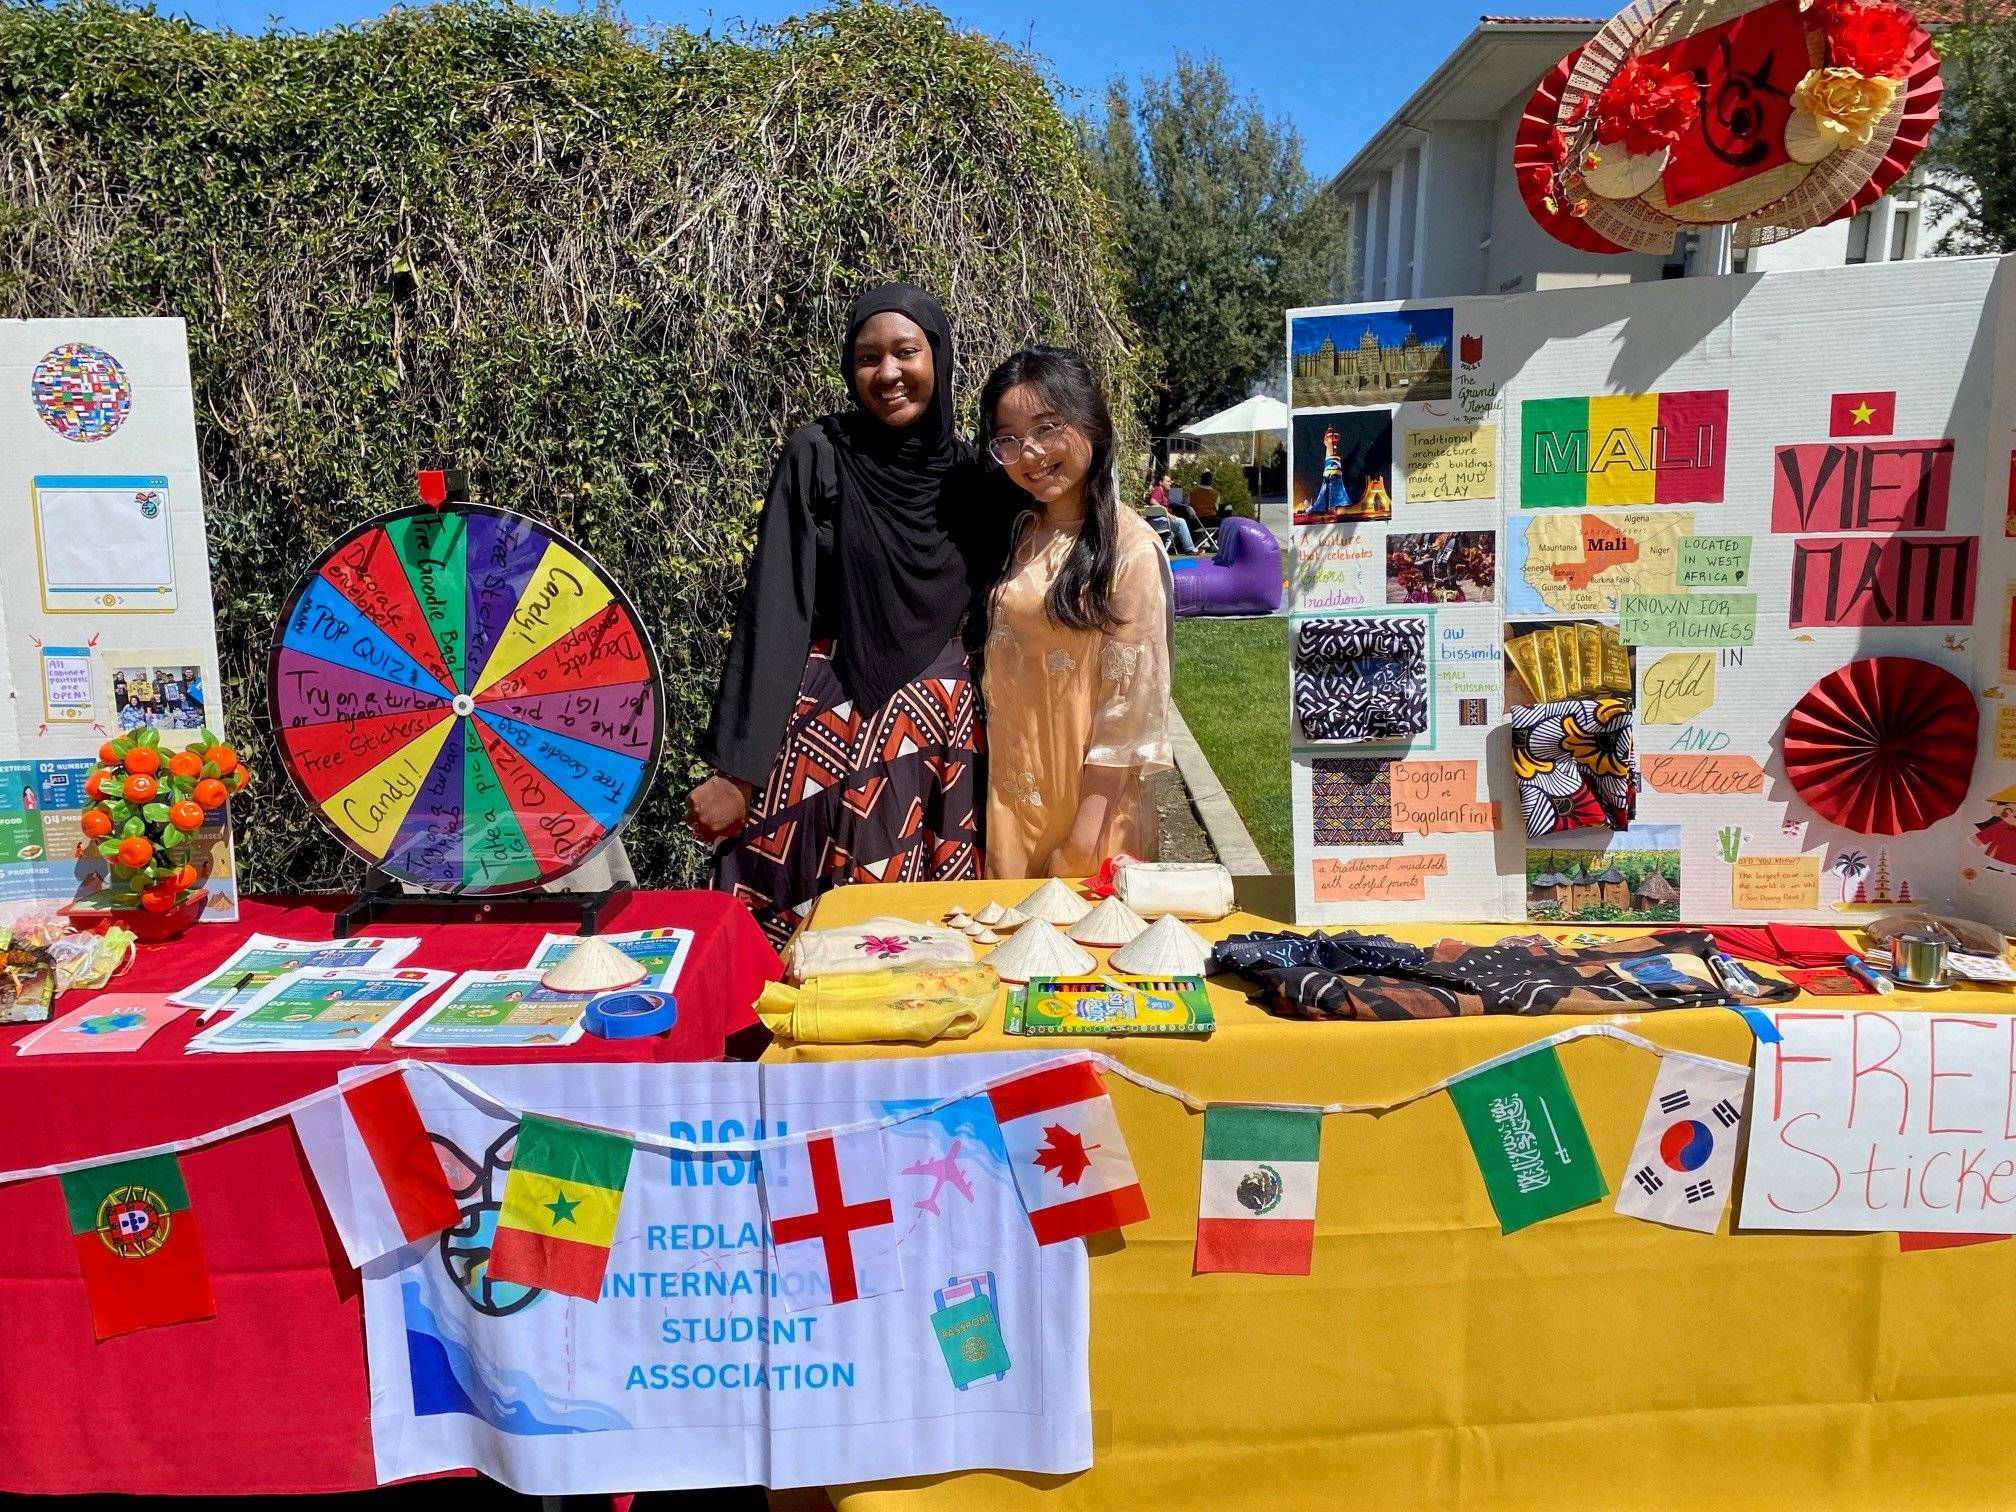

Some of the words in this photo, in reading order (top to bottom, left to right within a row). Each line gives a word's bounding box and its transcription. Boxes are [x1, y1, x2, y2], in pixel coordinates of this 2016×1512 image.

[1455, 375, 1476, 385] The
[1458, 382, 1498, 408] Grand
[1409, 431, 1473, 446] Traditional
[1412, 447, 1477, 459] architecture
[1533, 424, 1715, 475] MALI
[1408, 462, 1440, 470] means
[1449, 458, 1494, 476] buildings
[1408, 472, 1434, 484] made
[1456, 472, 1487, 483] MUD
[1777, 442, 1955, 531] VIET
[1411, 490, 1427, 499] and
[1433, 485, 1469, 498] CLAY
[1624, 515, 1650, 524] Algeria
[1539, 544, 1577, 552] Mauritania
[1587, 537, 1628, 551] Mali
[1650, 546, 1670, 555] Niger
[1684, 539, 1739, 550] LOCATED
[1327, 548, 1373, 561] celebrates
[1684, 556, 1696, 564] IN
[1707, 556, 1742, 567] WEST
[1684, 571, 1728, 581] AFRICA
[416, 558, 448, 622] Goodie
[1300, 589, 1365, 608] Traditions
[512, 567, 584, 644] Candy!
[1625, 598, 1690, 615] KNOWN
[1700, 599, 1730, 616] FOR
[311, 604, 350, 643] POP
[1625, 619, 1650, 632] ITS
[1667, 621, 1754, 640] RICHNESS
[1443, 628, 1464, 640] aw
[1441, 644, 1501, 660] bissimila
[1722, 647, 1743, 667] IN
[533, 669, 548, 679] a
[285, 670, 330, 717] Try
[336, 693, 359, 706] on
[366, 691, 378, 703] a
[384, 689, 446, 709] turban
[500, 679, 527, 696] red
[1643, 654, 1712, 725] Gold
[511, 700, 543, 720] pic
[292, 715, 309, 727] or
[557, 713, 576, 728] a
[591, 720, 649, 747] Take
[1668, 726, 1731, 751] AND
[296, 749, 346, 775] Free
[350, 714, 433, 756] Stickers!
[40, 763, 55, 772] 02
[427, 741, 459, 798] turban
[537, 741, 590, 780] Goodie
[472, 759, 495, 795] pic
[1394, 764, 1466, 800] Bogolan
[1649, 756, 1762, 792] Culture
[342, 759, 421, 834] Candy!
[592, 769, 626, 804] Free
[1441, 789, 1451, 798] or
[431, 799, 443, 817] a
[484, 807, 498, 822] a
[427, 825, 442, 844] on
[539, 810, 577, 860] POP
[480, 826, 511, 880] Take
[1331, 857, 1391, 873] traditional
[1397, 857, 1445, 871] mudcloth
[1322, 877, 1342, 890] with
[1350, 874, 1385, 896] colorful
[1773, 1011, 2016, 1140] FRE
[669, 1119, 789, 1188] RISA!
[662, 1316, 818, 1345] STUDENT
[941, 1313, 991, 1339] PASSPORT
[625, 1362, 855, 1391] ASSOCIATION
